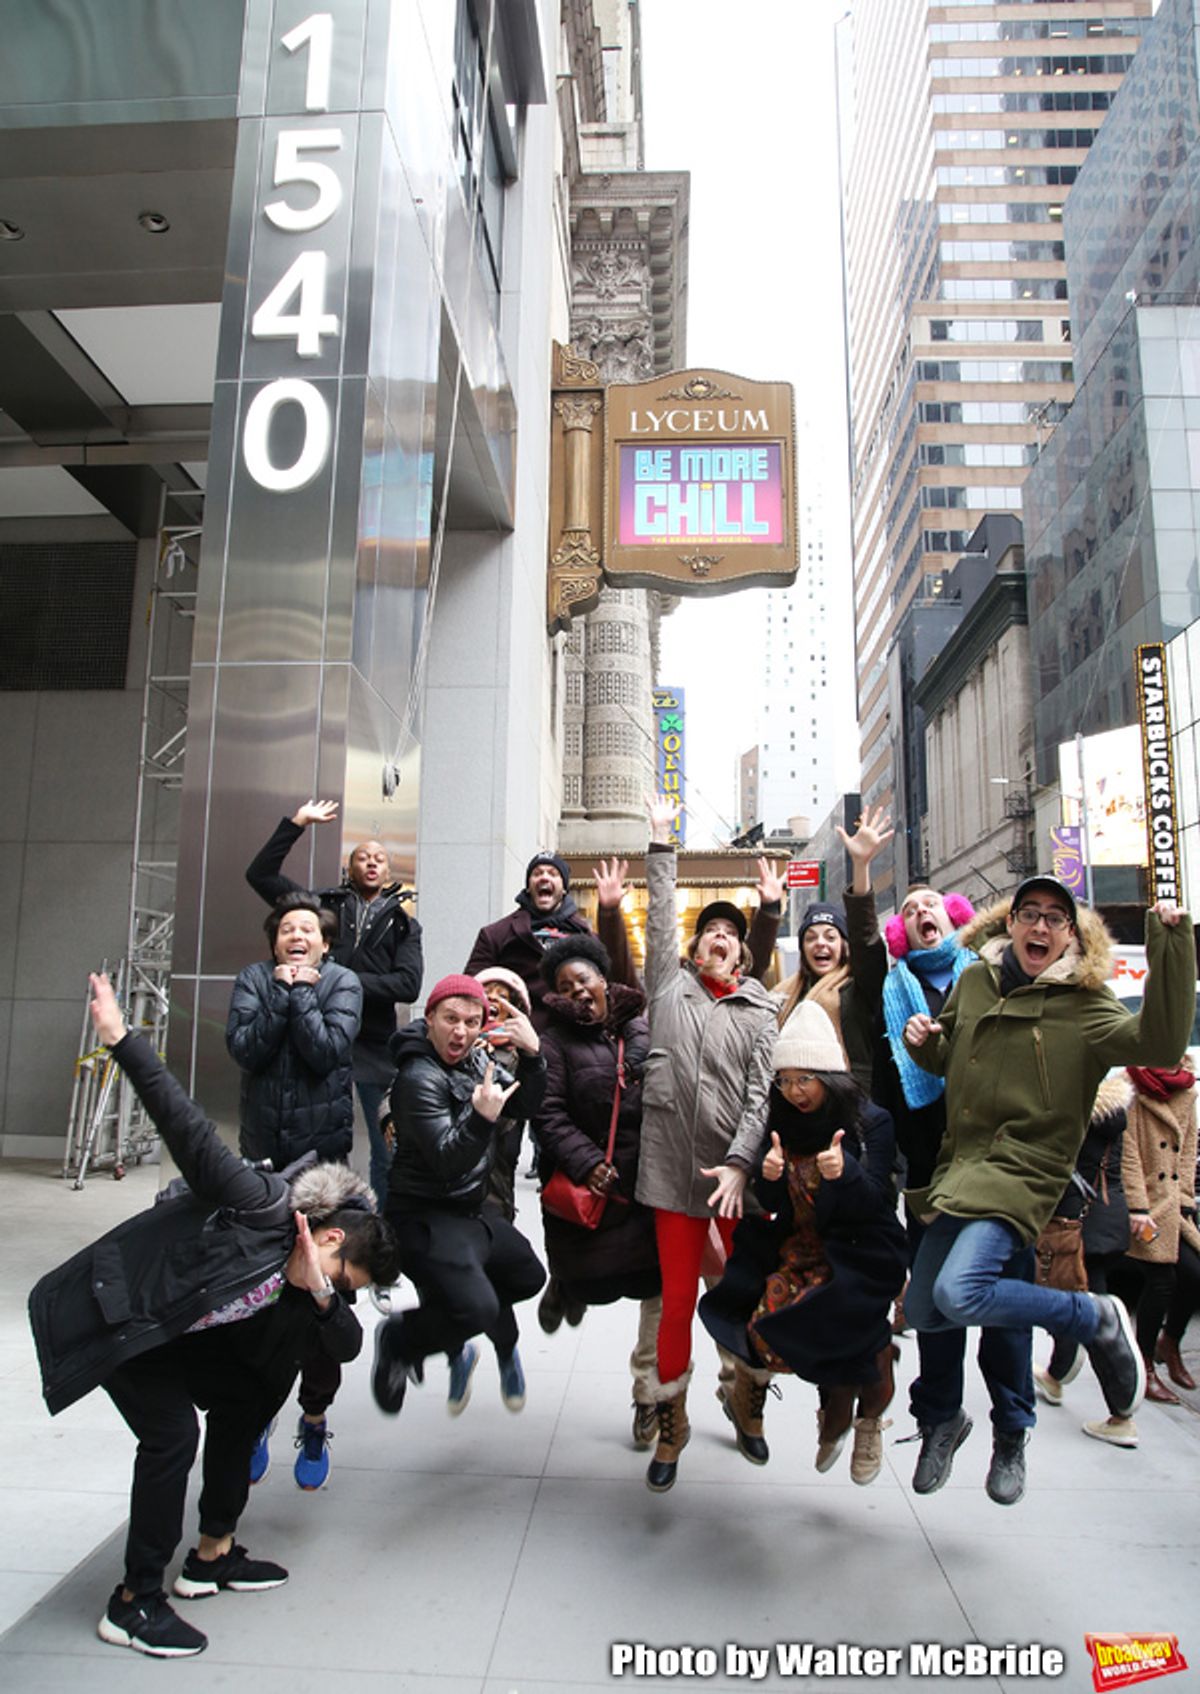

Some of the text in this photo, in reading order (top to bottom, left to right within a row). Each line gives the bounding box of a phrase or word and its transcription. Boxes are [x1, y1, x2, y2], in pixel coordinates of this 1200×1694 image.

[243, 13, 343, 491] 1540
[630, 409, 769, 433] LYCEUM
[634, 448, 768, 481] BE MORE
[1142, 657, 1171, 810] STARBUCKS
